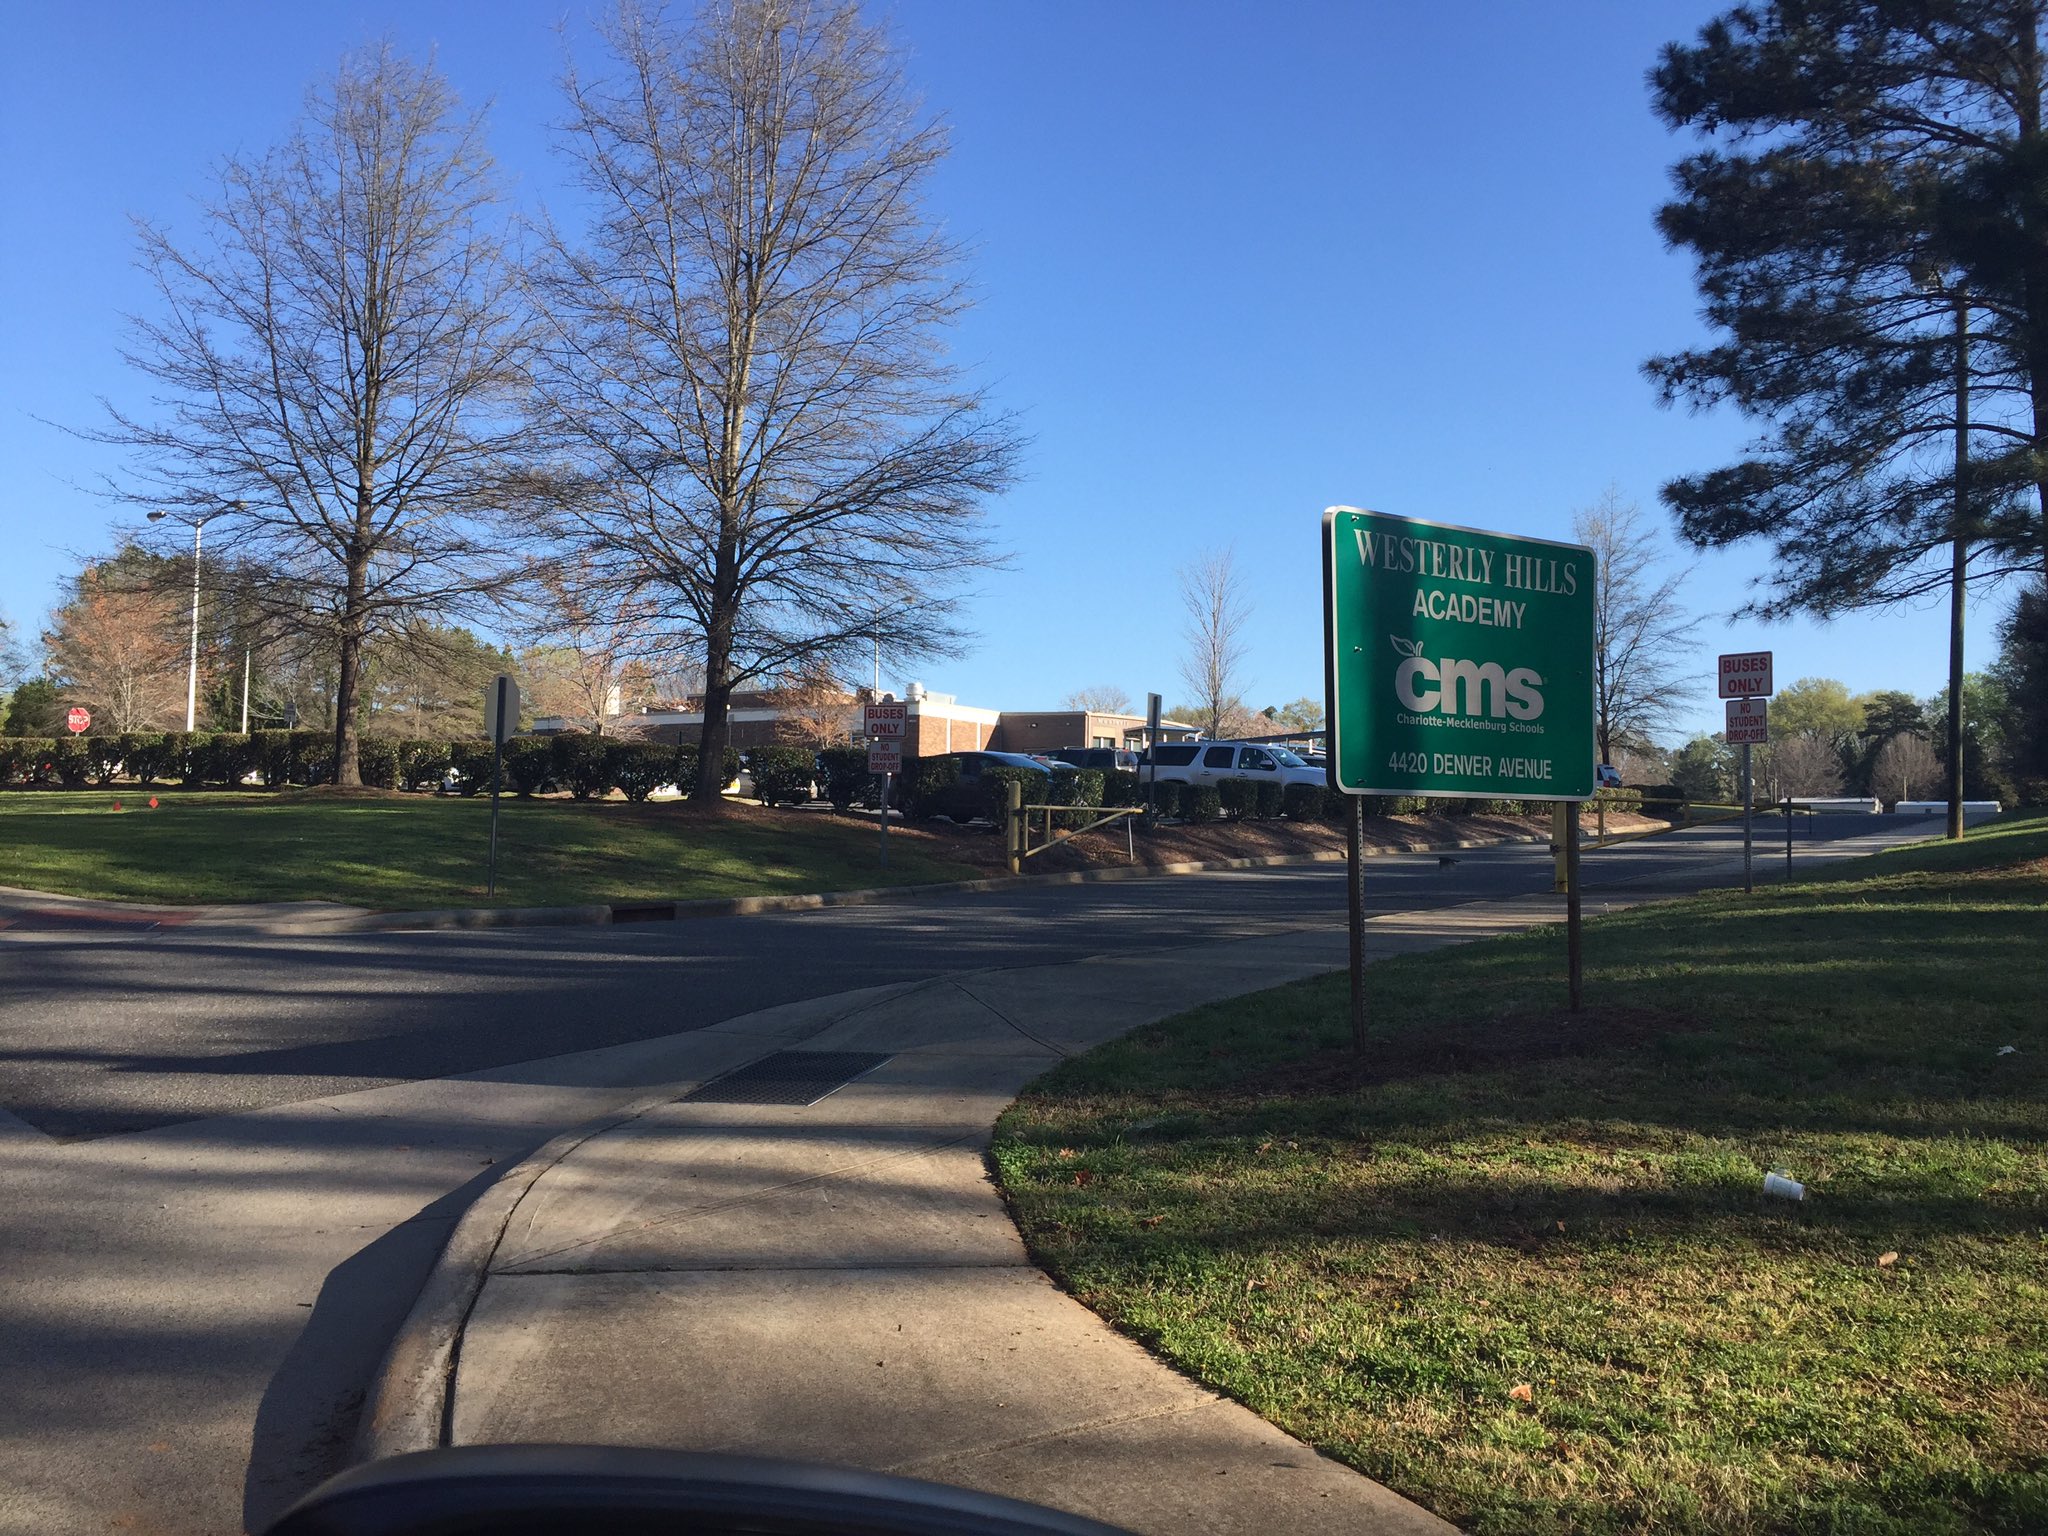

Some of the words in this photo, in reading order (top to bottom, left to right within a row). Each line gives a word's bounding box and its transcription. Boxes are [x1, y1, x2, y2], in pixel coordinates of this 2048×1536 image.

[1353, 528, 1495, 584] WESTERLY
[1504, 553, 1577, 596] HILLS
[1412, 588, 1527, 629] ACADEMY
[1723, 657, 1768, 673] BUSES
[1395, 655, 1545, 721] cms
[1727, 677, 1764, 693] ONLY
[868, 708, 904, 719] BUSES
[1740, 703, 1751, 714] NO
[1396, 713, 1507, 733] Charlotte-Mecklenburg
[1509, 721, 1545, 734] Schools
[1729, 715, 1764, 728] STUDENT
[871, 723, 900, 734] ONLY
[1728, 728, 1765, 741] DROP-OFF
[880, 743, 890, 751] NO
[871, 752, 899, 761] STUDENT
[870, 762, 900, 771] DROP-OFF
[1388, 751, 1428, 774] 4420
[1433, 753, 1492, 777] DENVER
[1498, 757, 1553, 780] AVENUE
